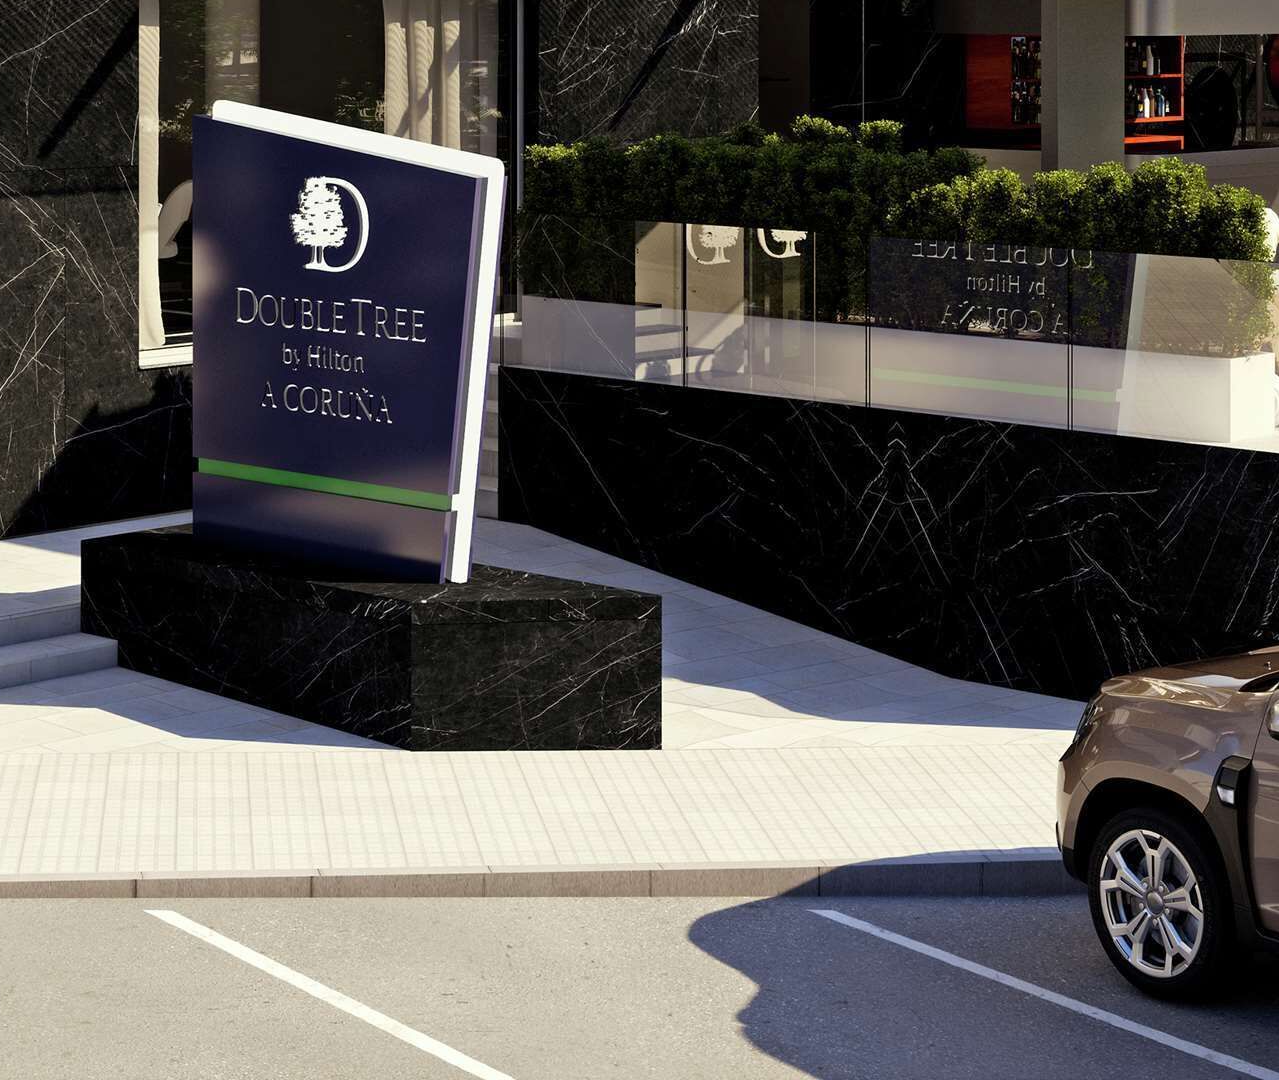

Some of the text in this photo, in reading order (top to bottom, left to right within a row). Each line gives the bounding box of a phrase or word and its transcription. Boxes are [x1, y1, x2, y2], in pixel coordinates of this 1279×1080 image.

[282, 342, 365, 373] by Hilton
[261, 380, 392, 424] A CORUÑA
